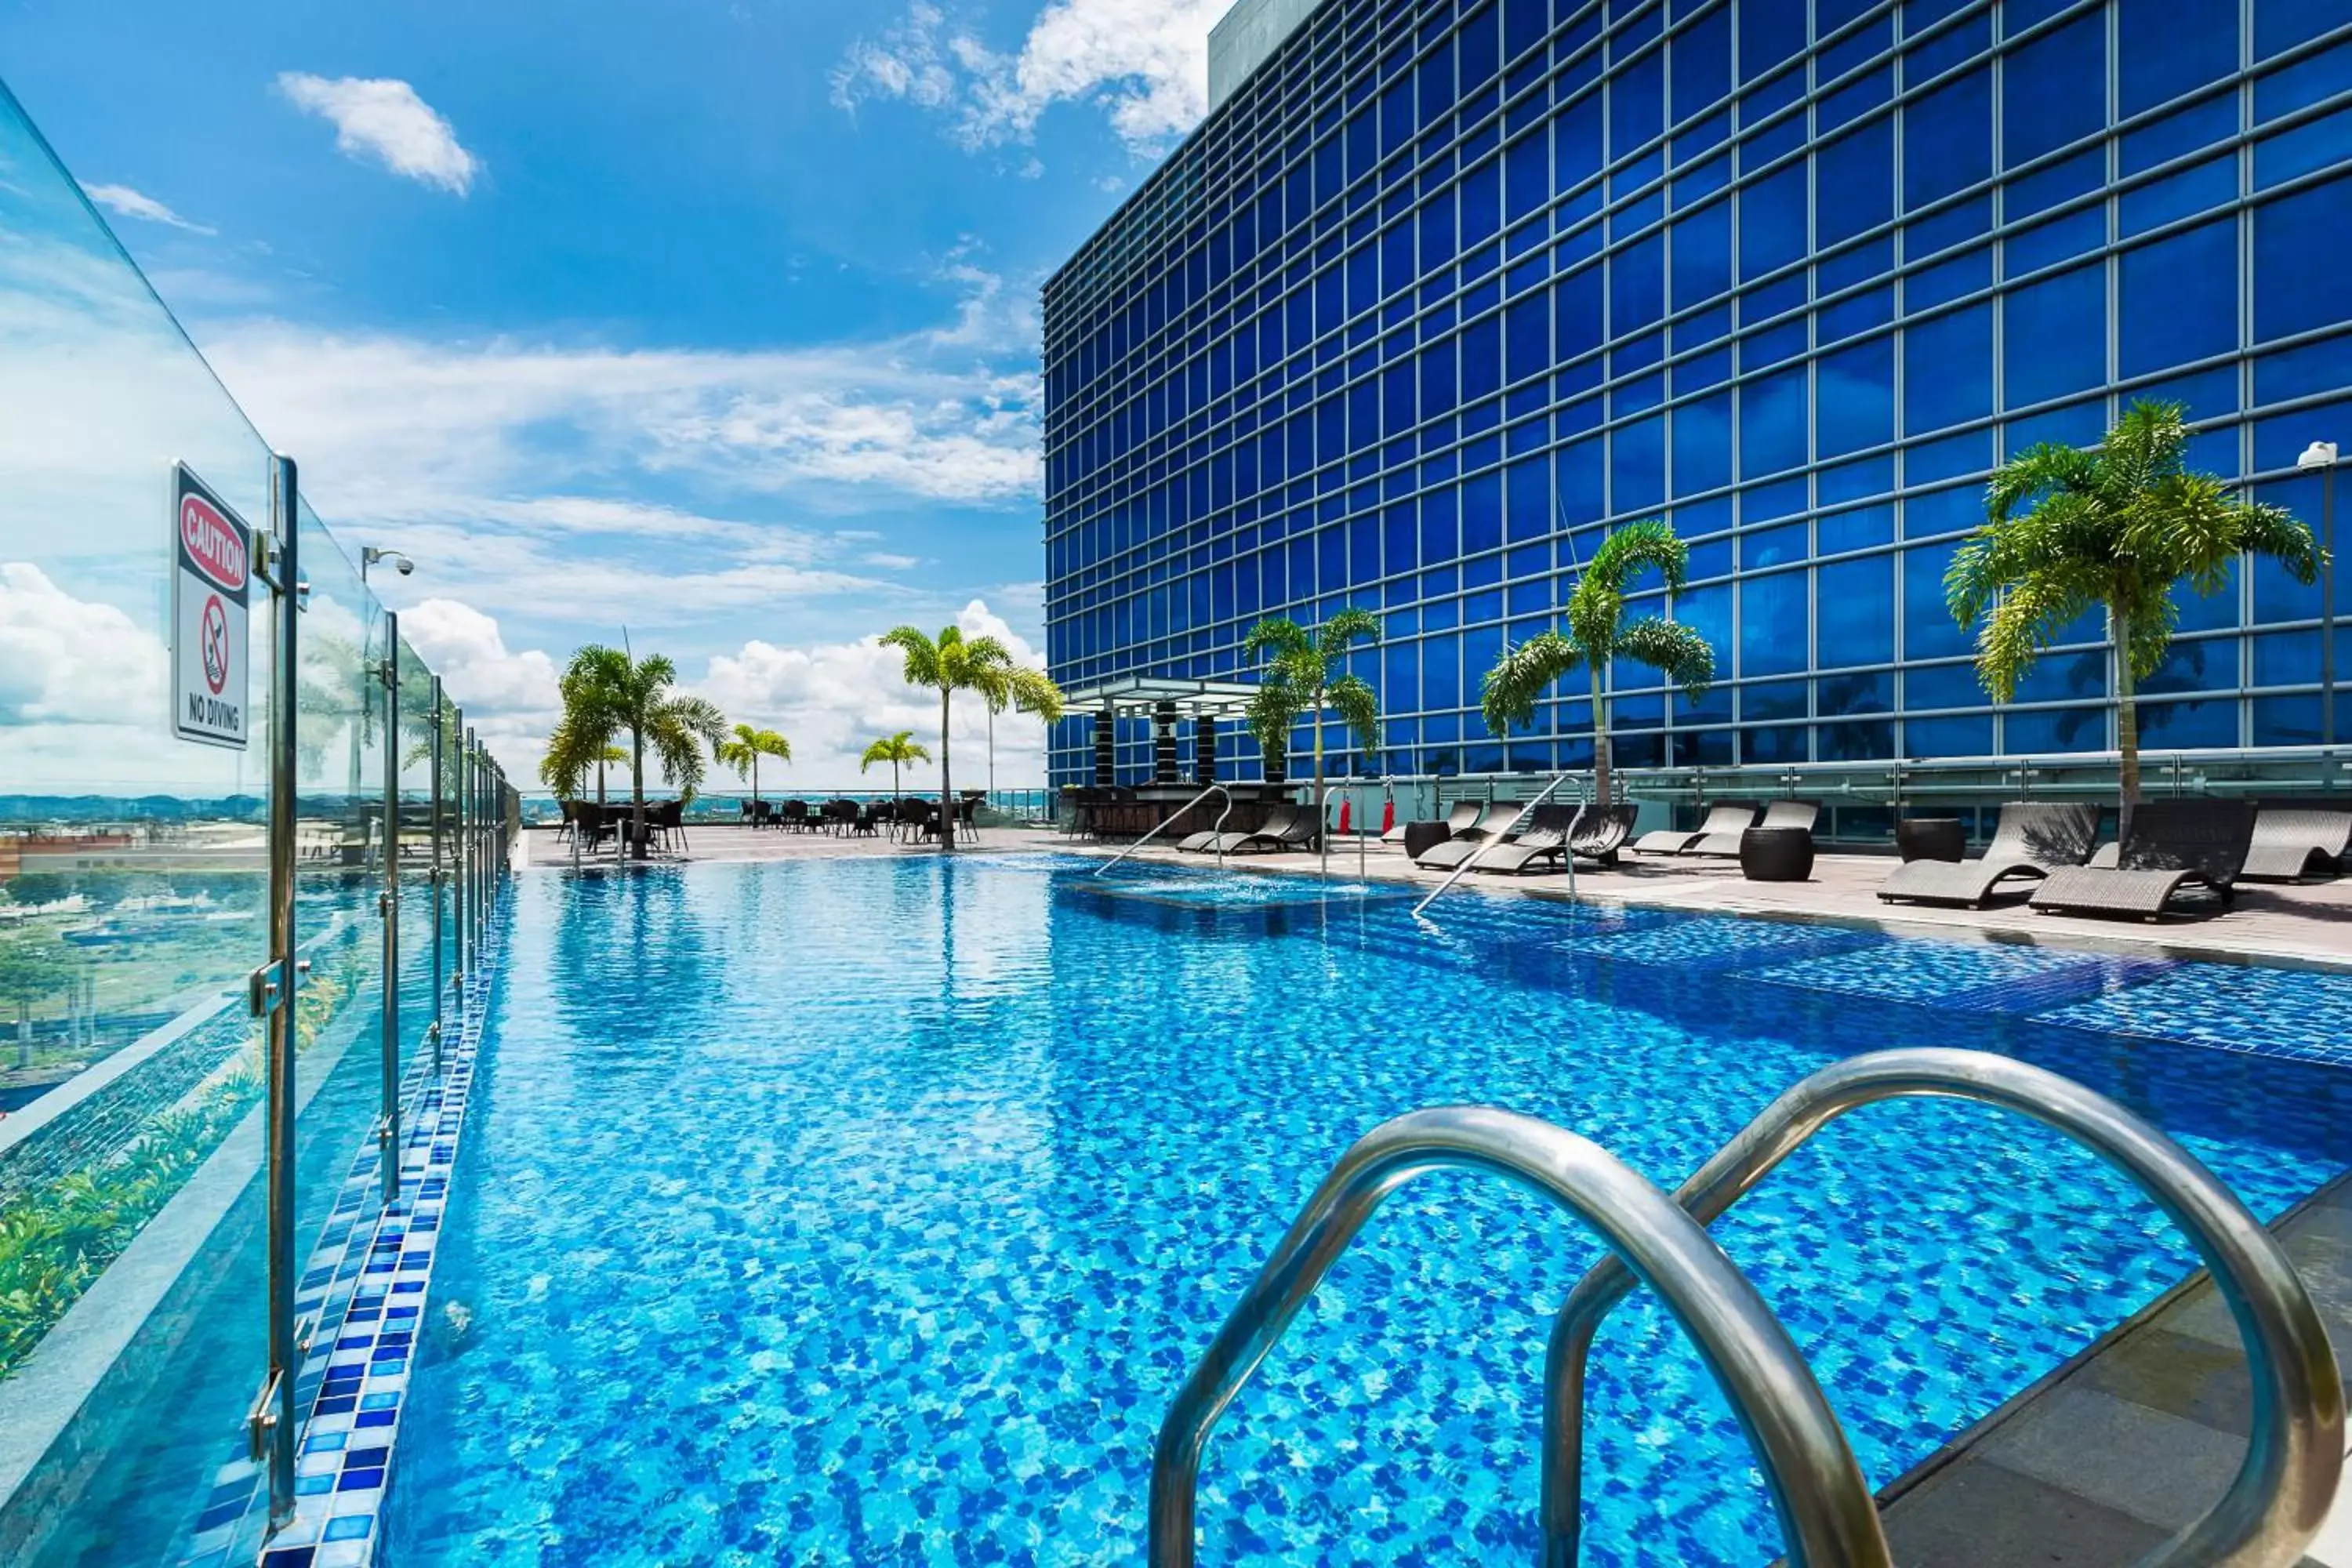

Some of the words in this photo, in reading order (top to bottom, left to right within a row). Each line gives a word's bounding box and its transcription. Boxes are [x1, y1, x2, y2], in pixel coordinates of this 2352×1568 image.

[187, 507, 242, 580] CAUTION
[189, 692, 204, 723] NO
[208, 698, 239, 731] DIVING
